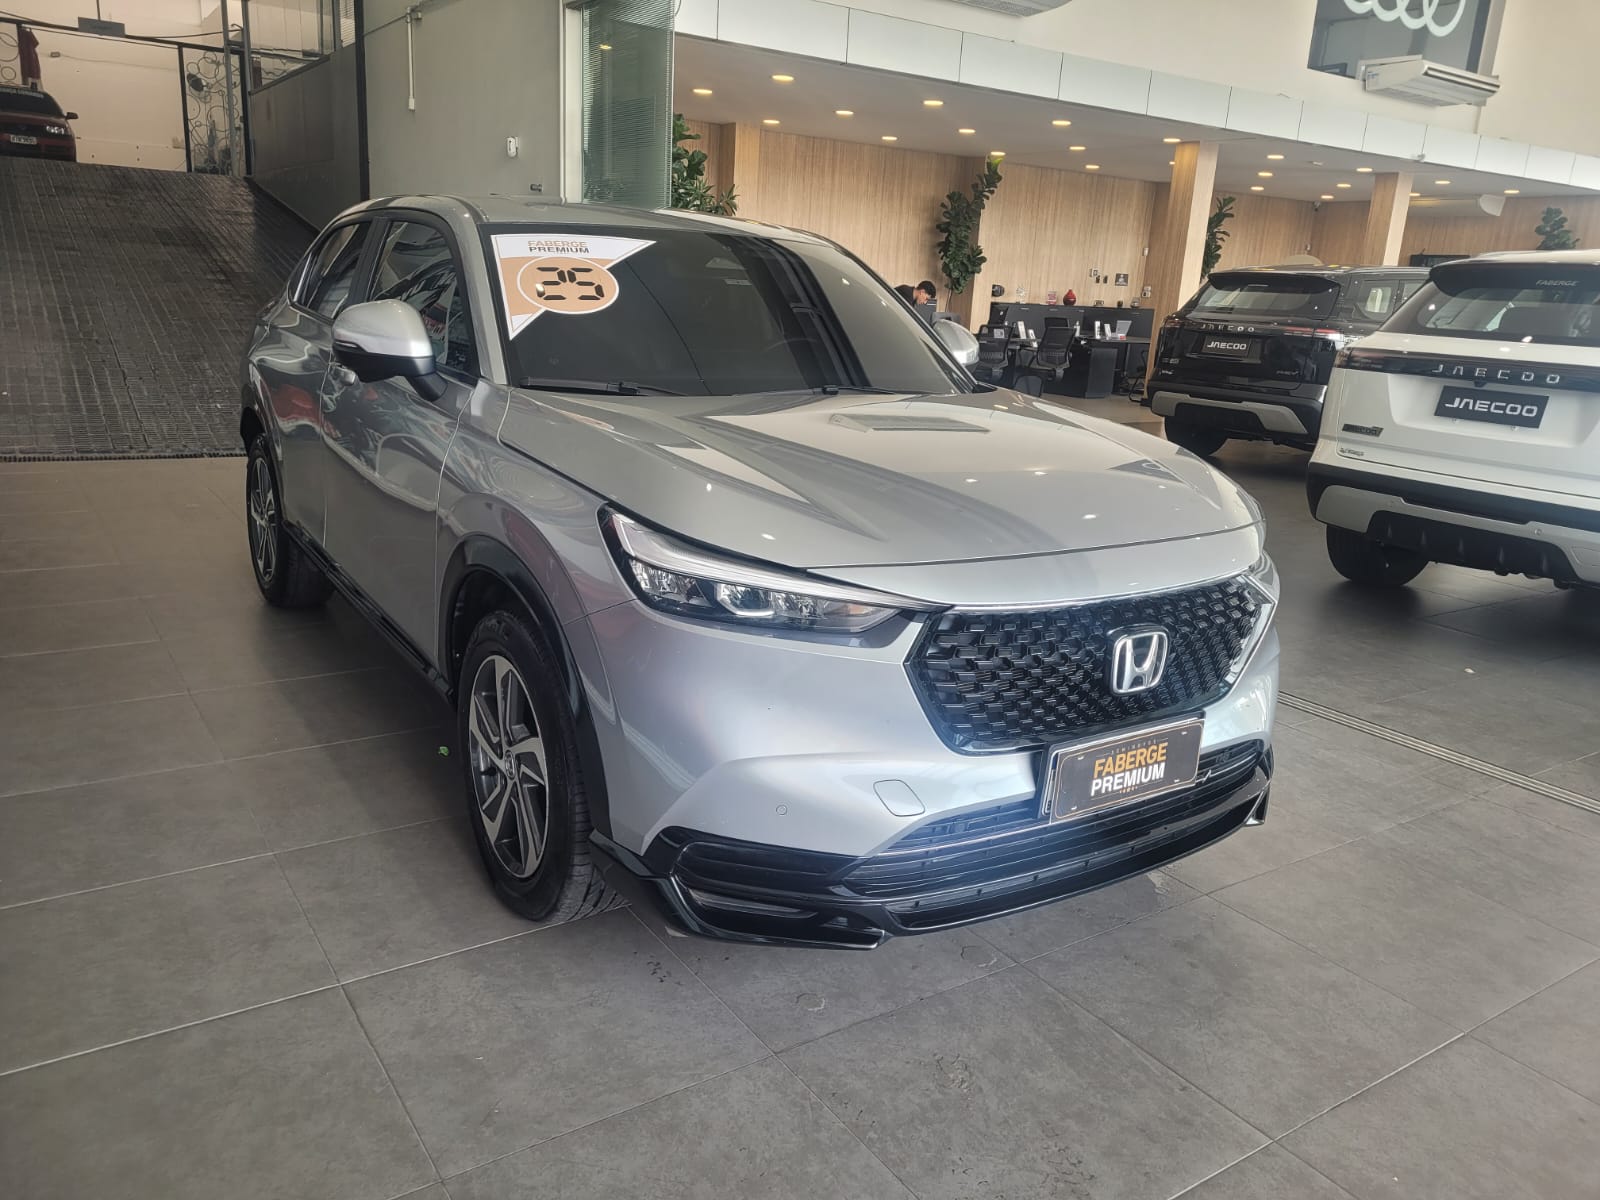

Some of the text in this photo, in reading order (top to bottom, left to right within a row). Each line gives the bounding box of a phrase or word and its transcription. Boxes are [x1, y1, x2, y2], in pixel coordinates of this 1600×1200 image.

[528, 240, 588, 248] FABERGE
[535, 267, 604, 300] 25
[1535, 279, 1579, 287] FABERGE
[1207, 341, 1247, 350] JAECOO
[1431, 364, 1561, 384] JAECOO
[1444, 397, 1539, 418] JAECOO
[1093, 742, 1169, 779] FABERGE
[1090, 762, 1166, 797] PREMIUM
